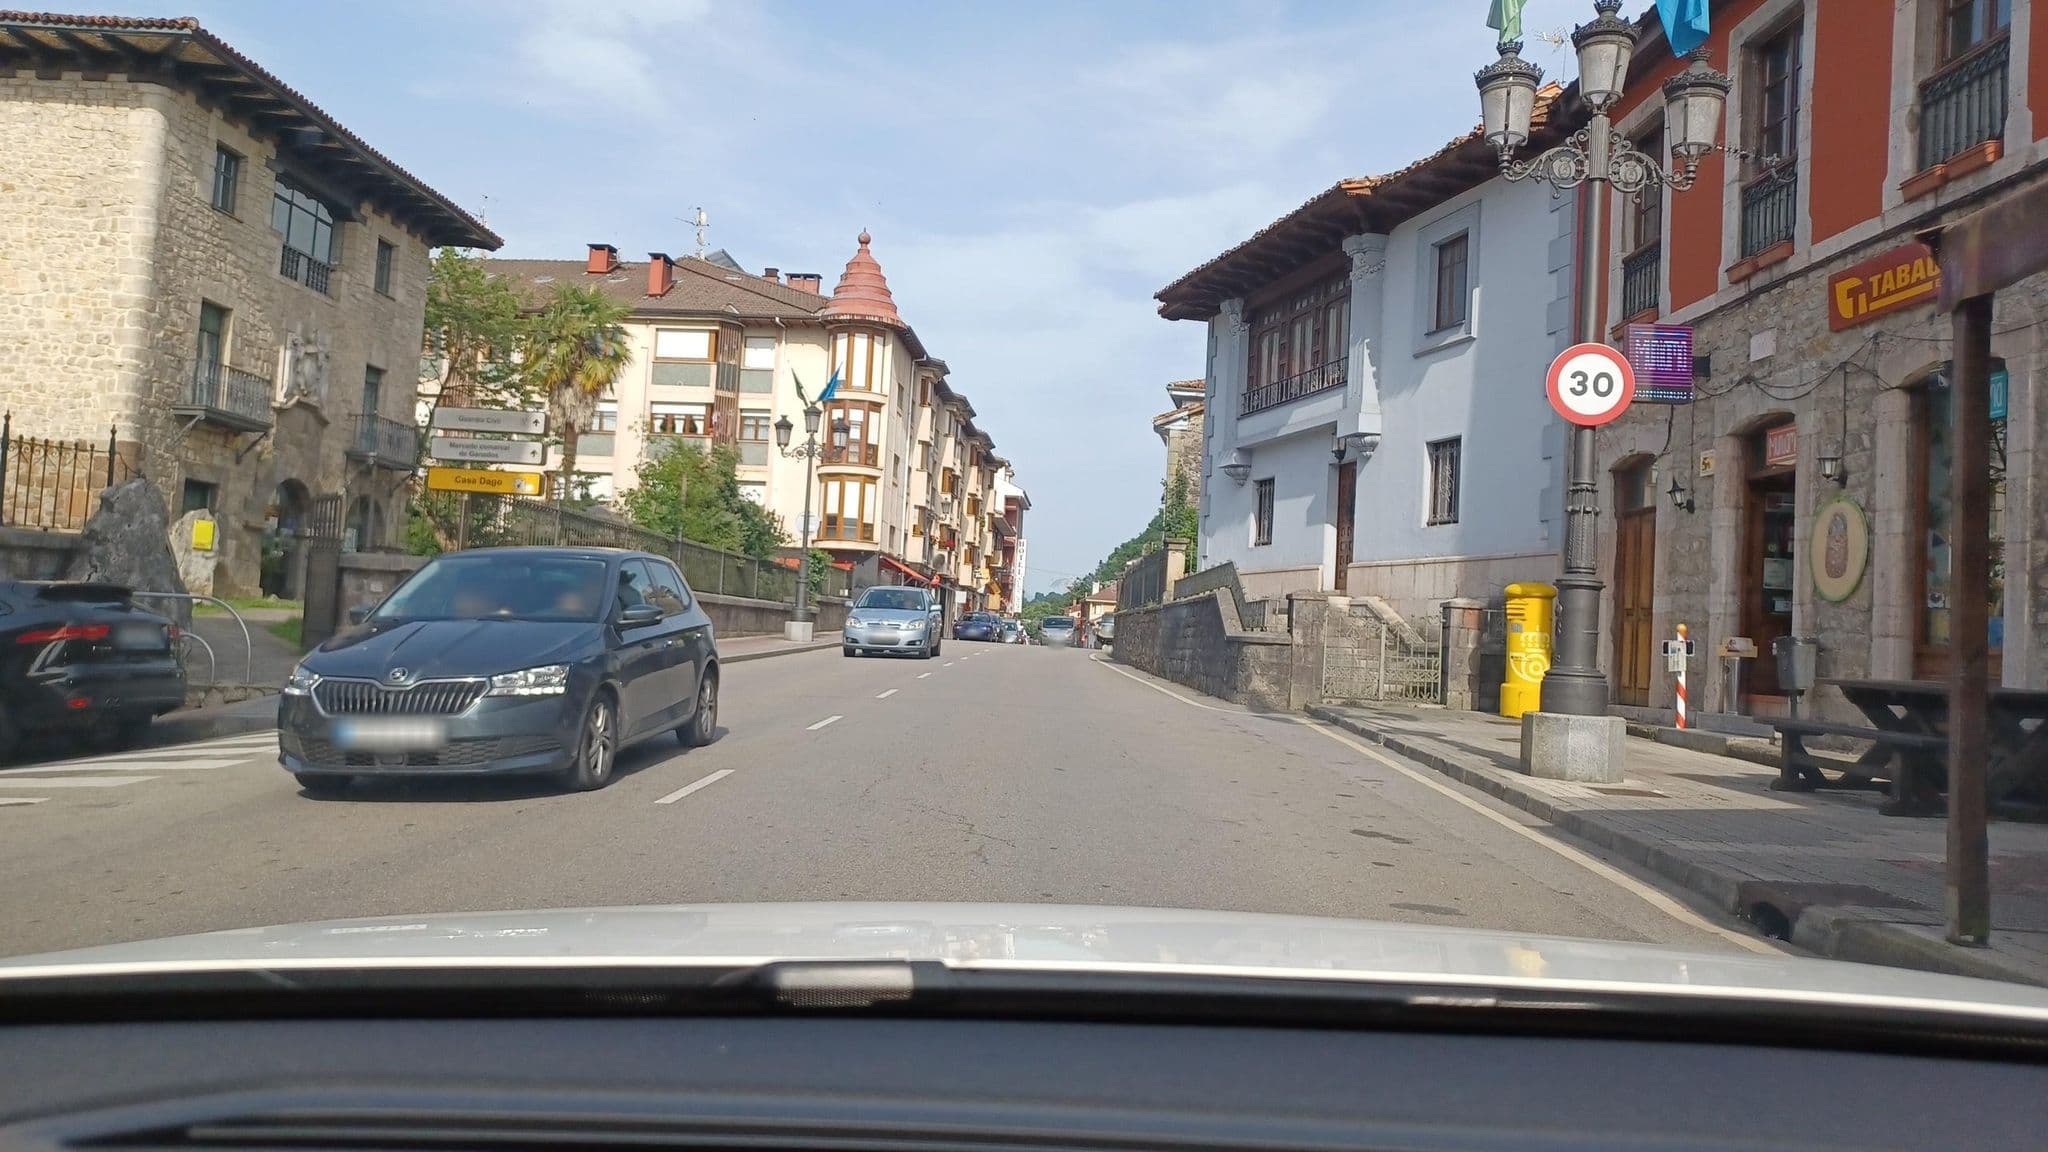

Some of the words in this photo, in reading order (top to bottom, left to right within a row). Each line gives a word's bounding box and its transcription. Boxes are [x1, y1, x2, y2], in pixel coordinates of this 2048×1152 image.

[1569, 370, 1614, 397] 30
[455, 475, 477, 485] Casa
[479, 476, 503, 487] Dago
